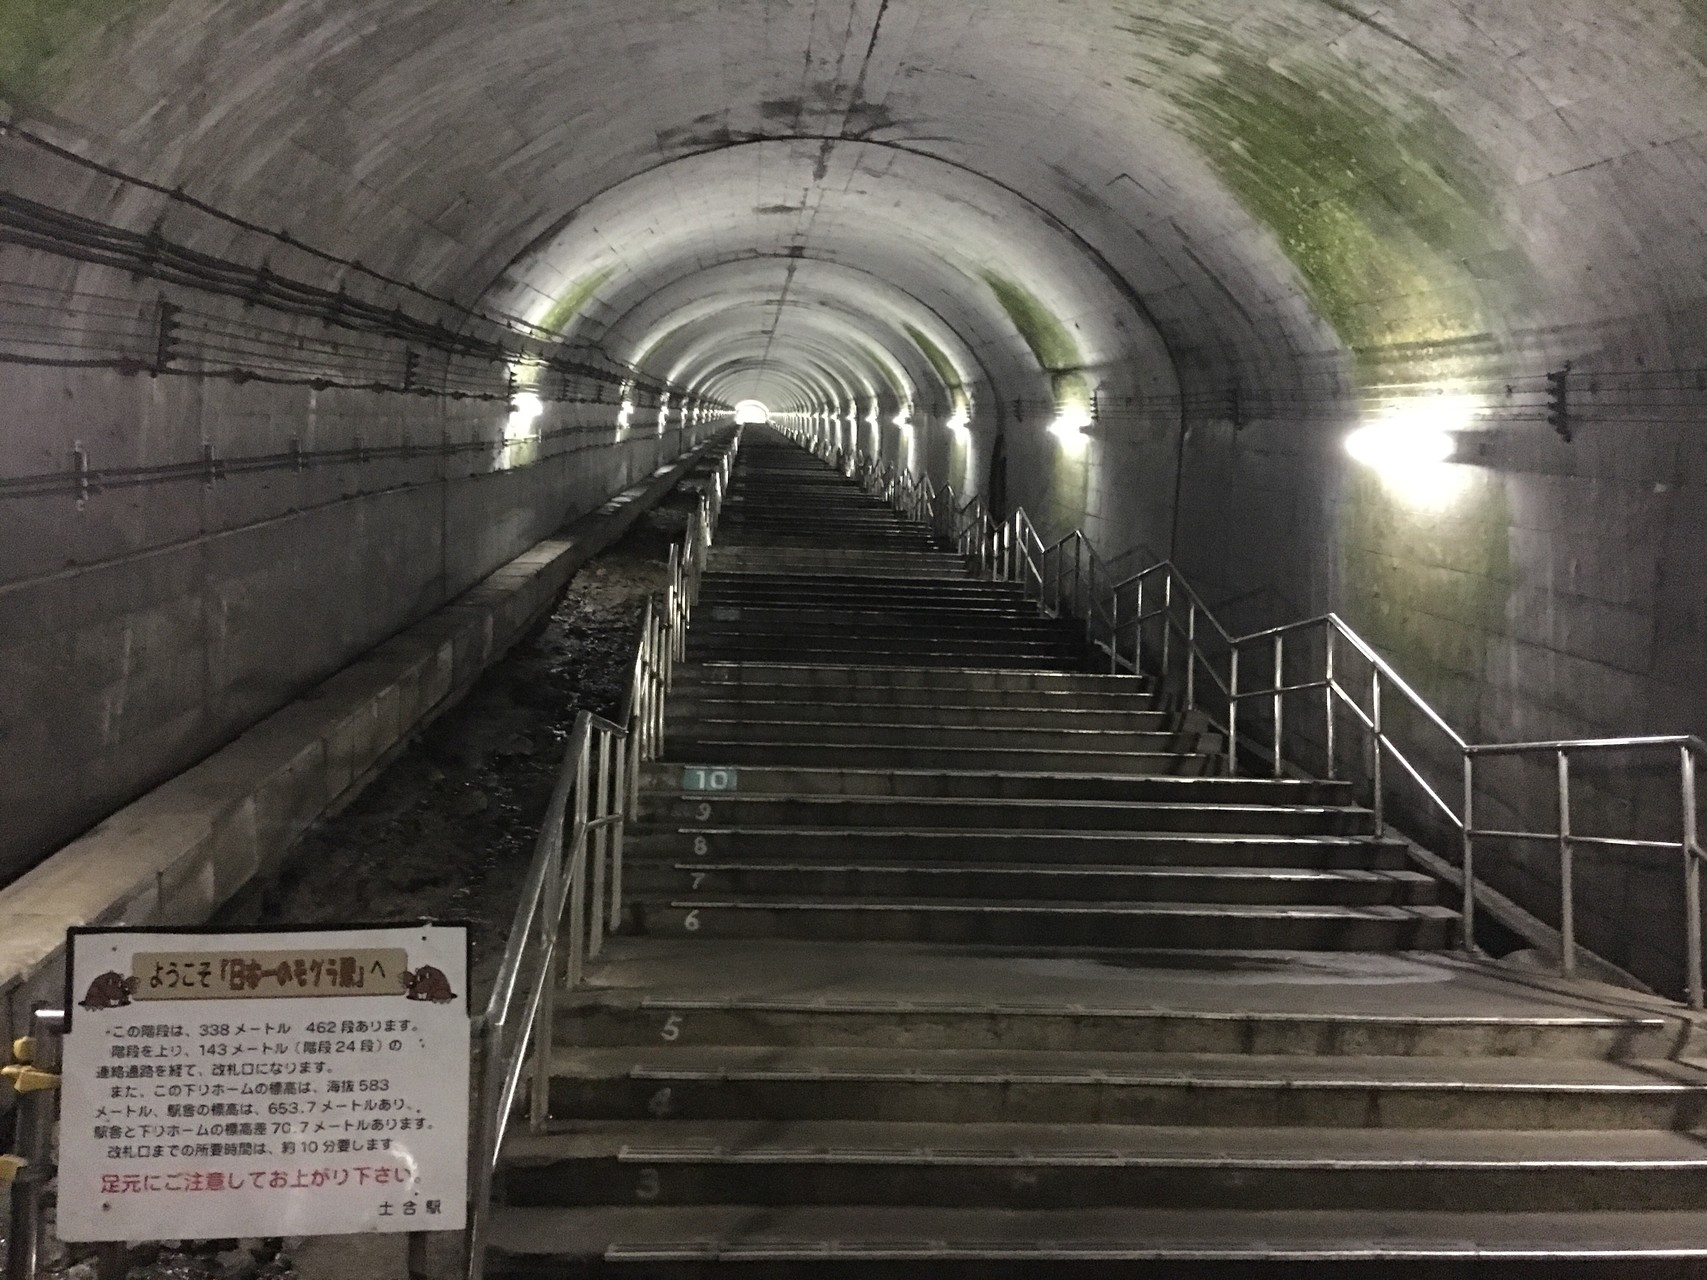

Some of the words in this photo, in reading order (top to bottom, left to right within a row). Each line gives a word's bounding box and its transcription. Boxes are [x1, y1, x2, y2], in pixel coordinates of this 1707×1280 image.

[695, 770, 728, 790] 10
[695, 802, 711, 821] 9
[693, 836, 708, 855] 8
[691, 872, 706, 889] 7
[685, 909, 700, 931] 6
[660, 1015, 682, 1040] 5
[650, 1087, 673, 1116] 4
[635, 1168, 661, 1199] 3
